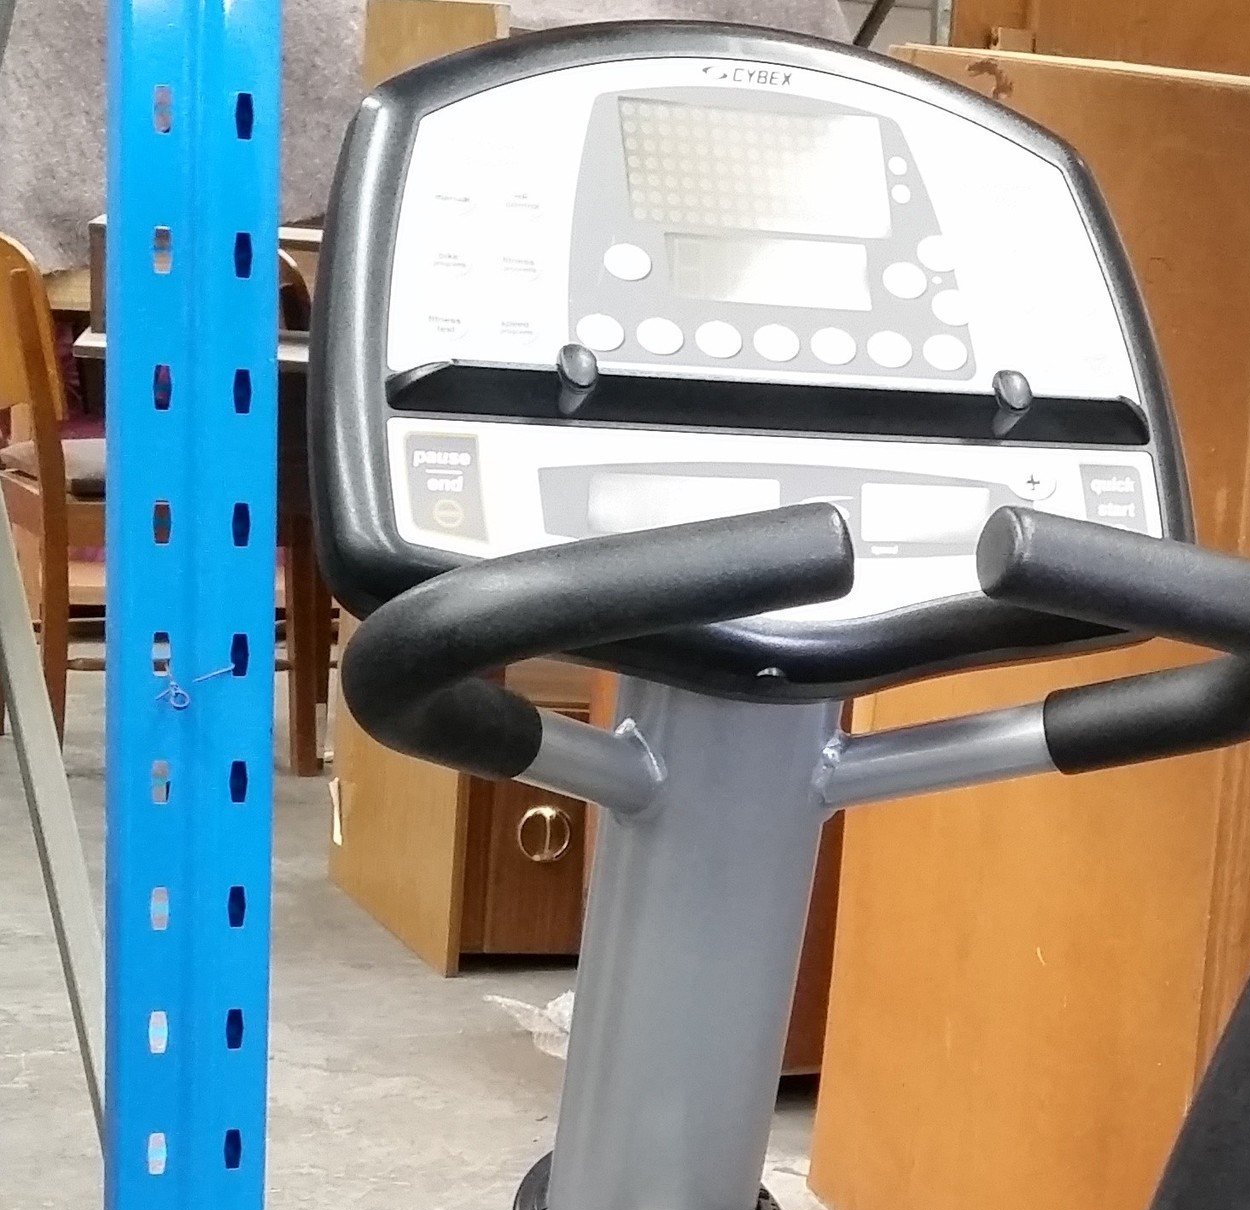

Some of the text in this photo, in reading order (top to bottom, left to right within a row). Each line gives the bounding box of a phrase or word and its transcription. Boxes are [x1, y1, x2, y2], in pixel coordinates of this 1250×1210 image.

[733, 67, 792, 86] CYBEX
[413, 450, 471, 467] pause
[427, 475, 464, 492] end
[1090, 477, 1136, 495] quick
[1098, 502, 1136, 518] start
